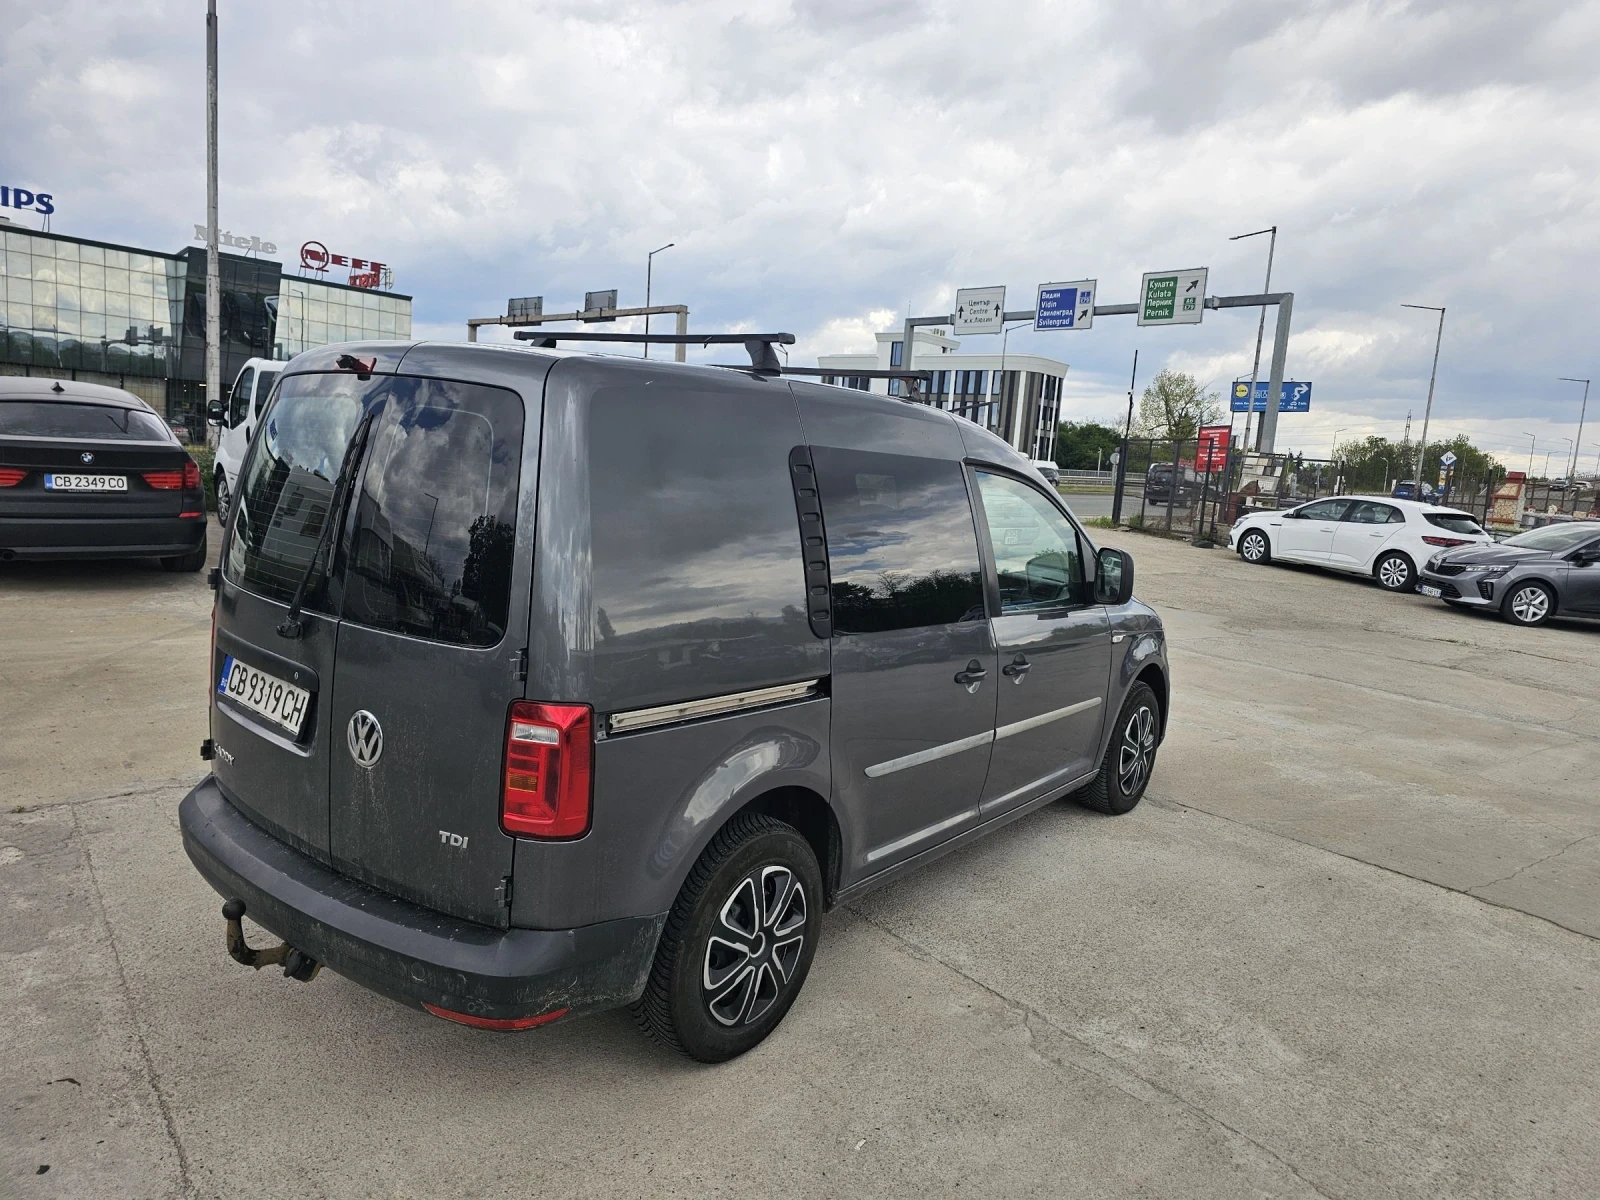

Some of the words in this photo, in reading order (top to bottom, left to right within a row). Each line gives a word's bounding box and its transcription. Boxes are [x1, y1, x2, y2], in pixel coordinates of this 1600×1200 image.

[301, 242, 386, 272] NEFF
[1149, 280, 1174, 289] Кулата
[1148, 290, 1171, 298] Kulata
[1147, 299, 1173, 307] Перник
[1040, 309, 1073, 317] Свиленград
[1146, 308, 1169, 316] Pernik
[1038, 318, 1070, 326] Svilengrad
[74, 477, 106, 488] 2349
[247, 673, 283, 714] 9319
[438, 830, 469, 849] TDI
